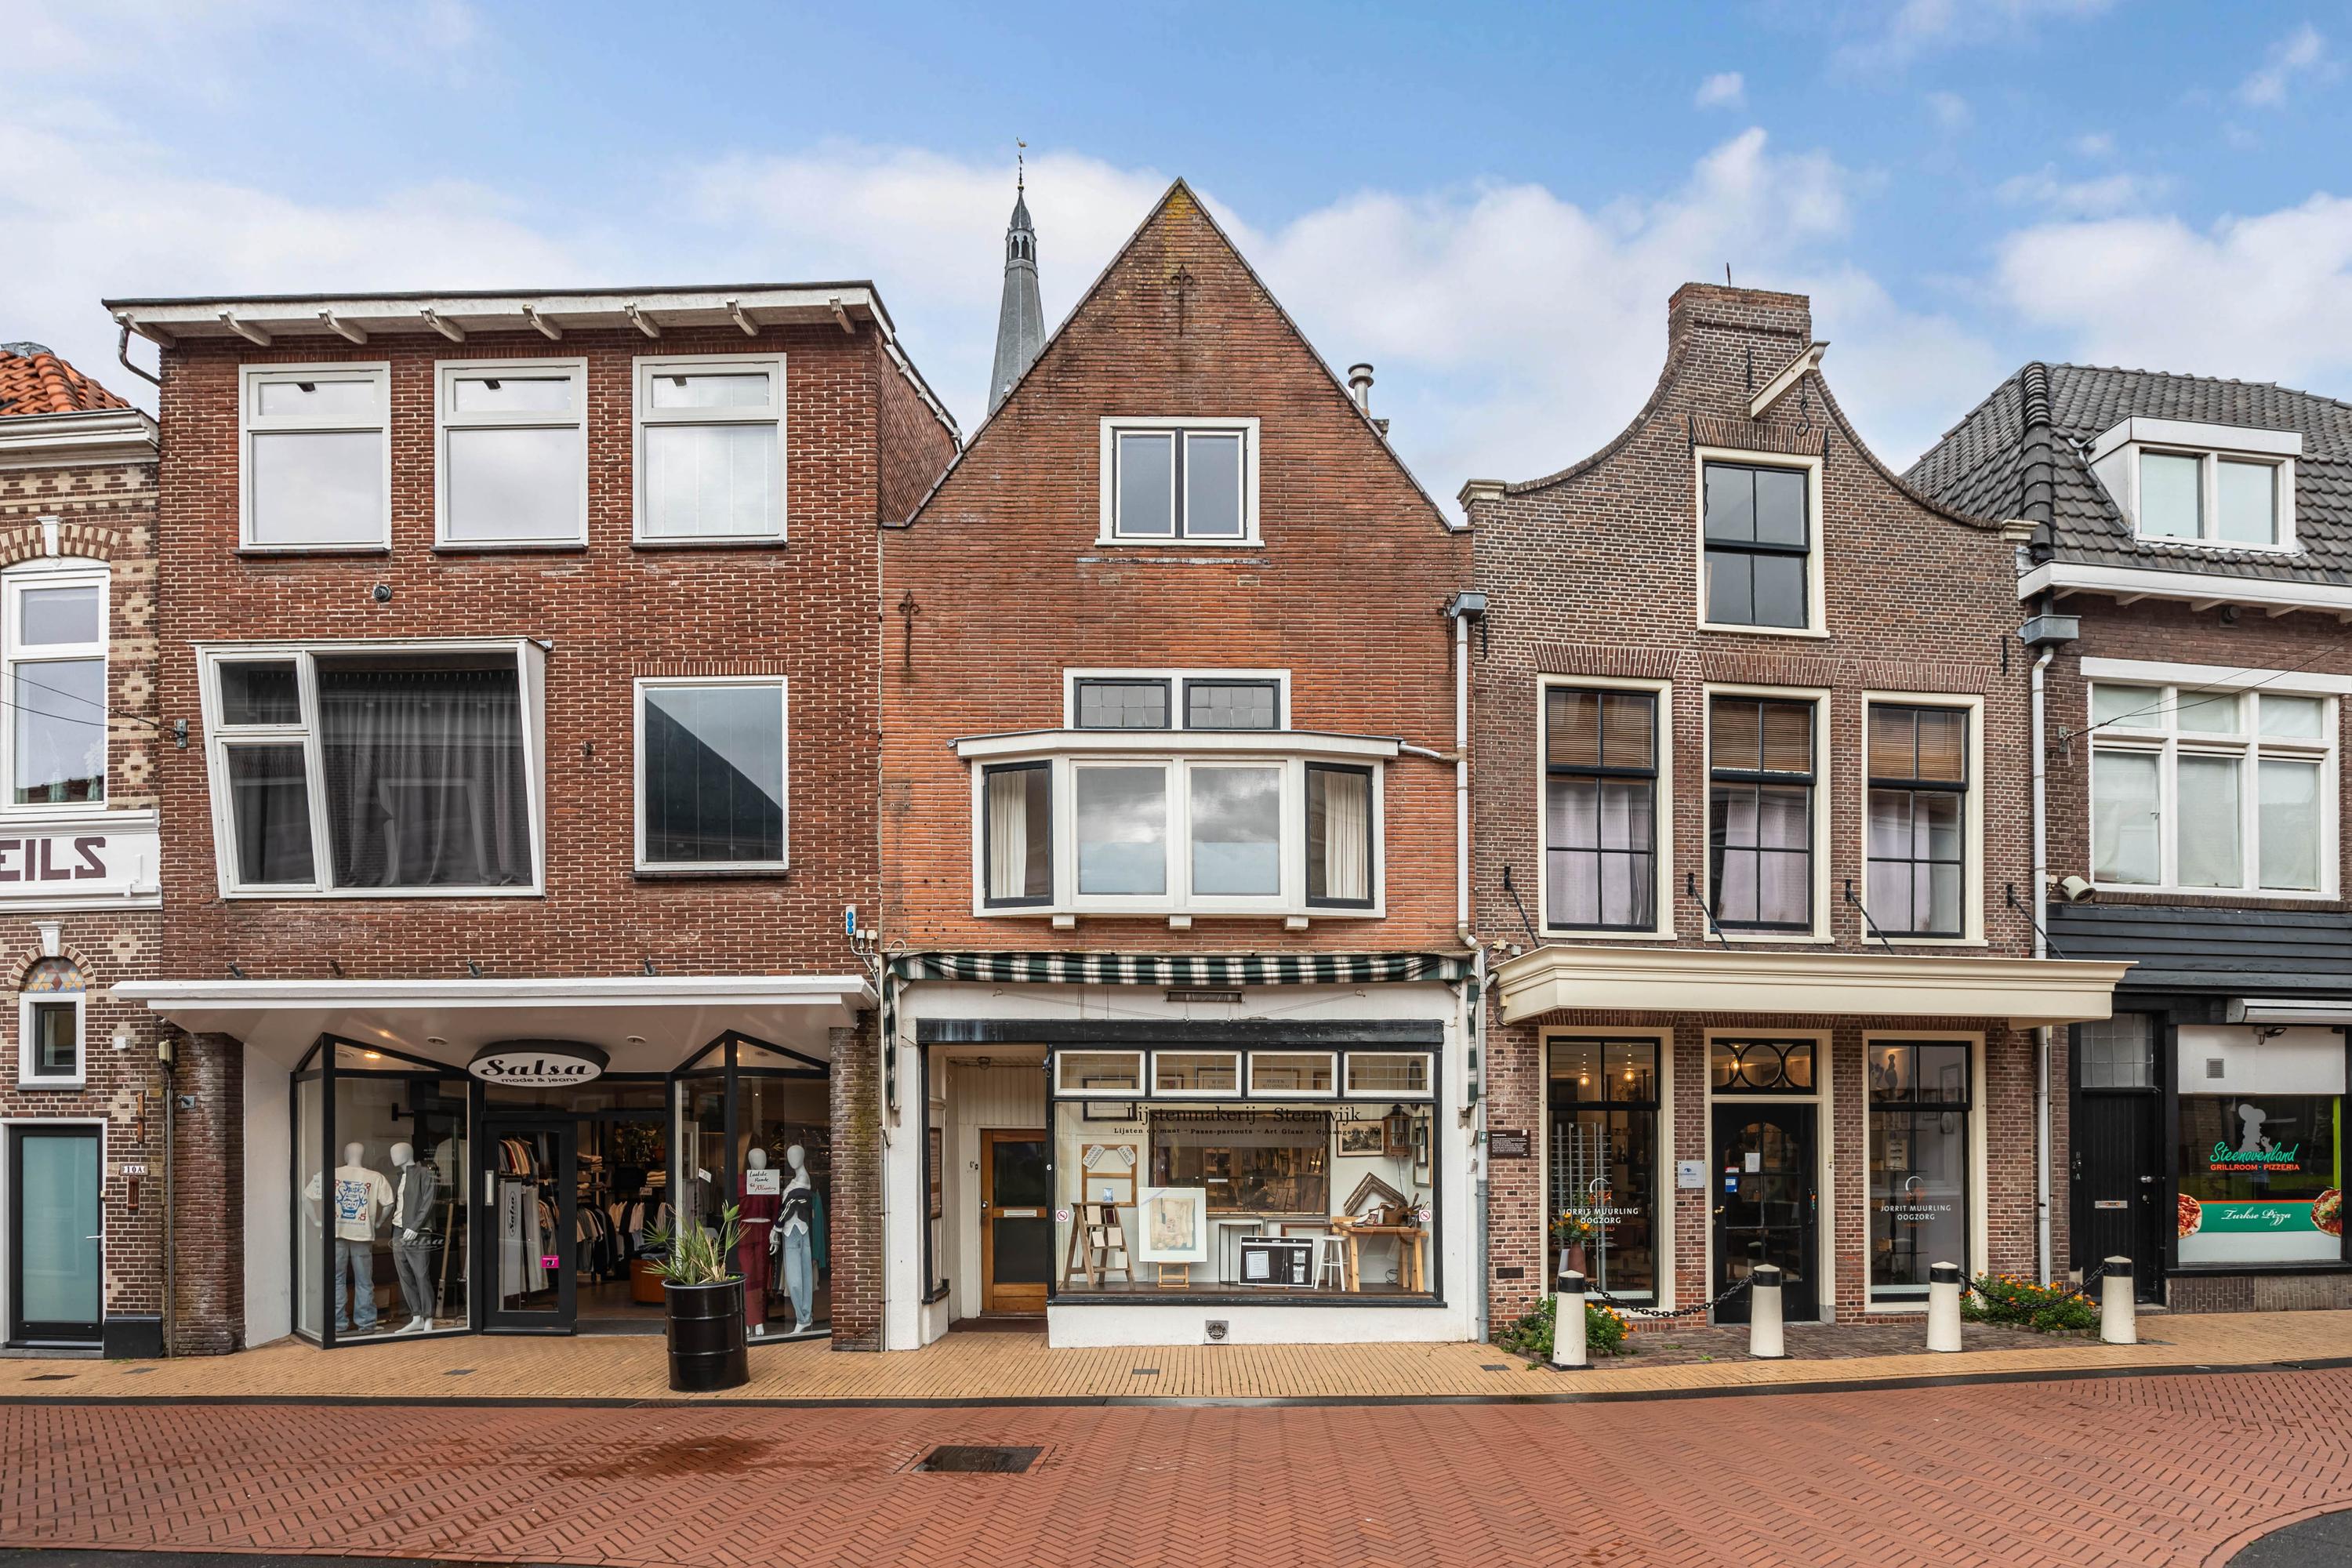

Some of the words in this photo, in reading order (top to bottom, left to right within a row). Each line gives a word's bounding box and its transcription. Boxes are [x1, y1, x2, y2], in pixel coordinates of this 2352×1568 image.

[0, 837, 106, 881] EILS
[481, 1059, 591, 1076] Salsa
[1127, 1106, 1255, 1125] Lijstenmakerij
[1273, 1106, 1361, 1126] Steenwijk
[2209, 1142, 2299, 1163] Steenovenland
[2220, 1207, 2259, 1220] Turkse
[2261, 1209, 2291, 1226] Pizza
